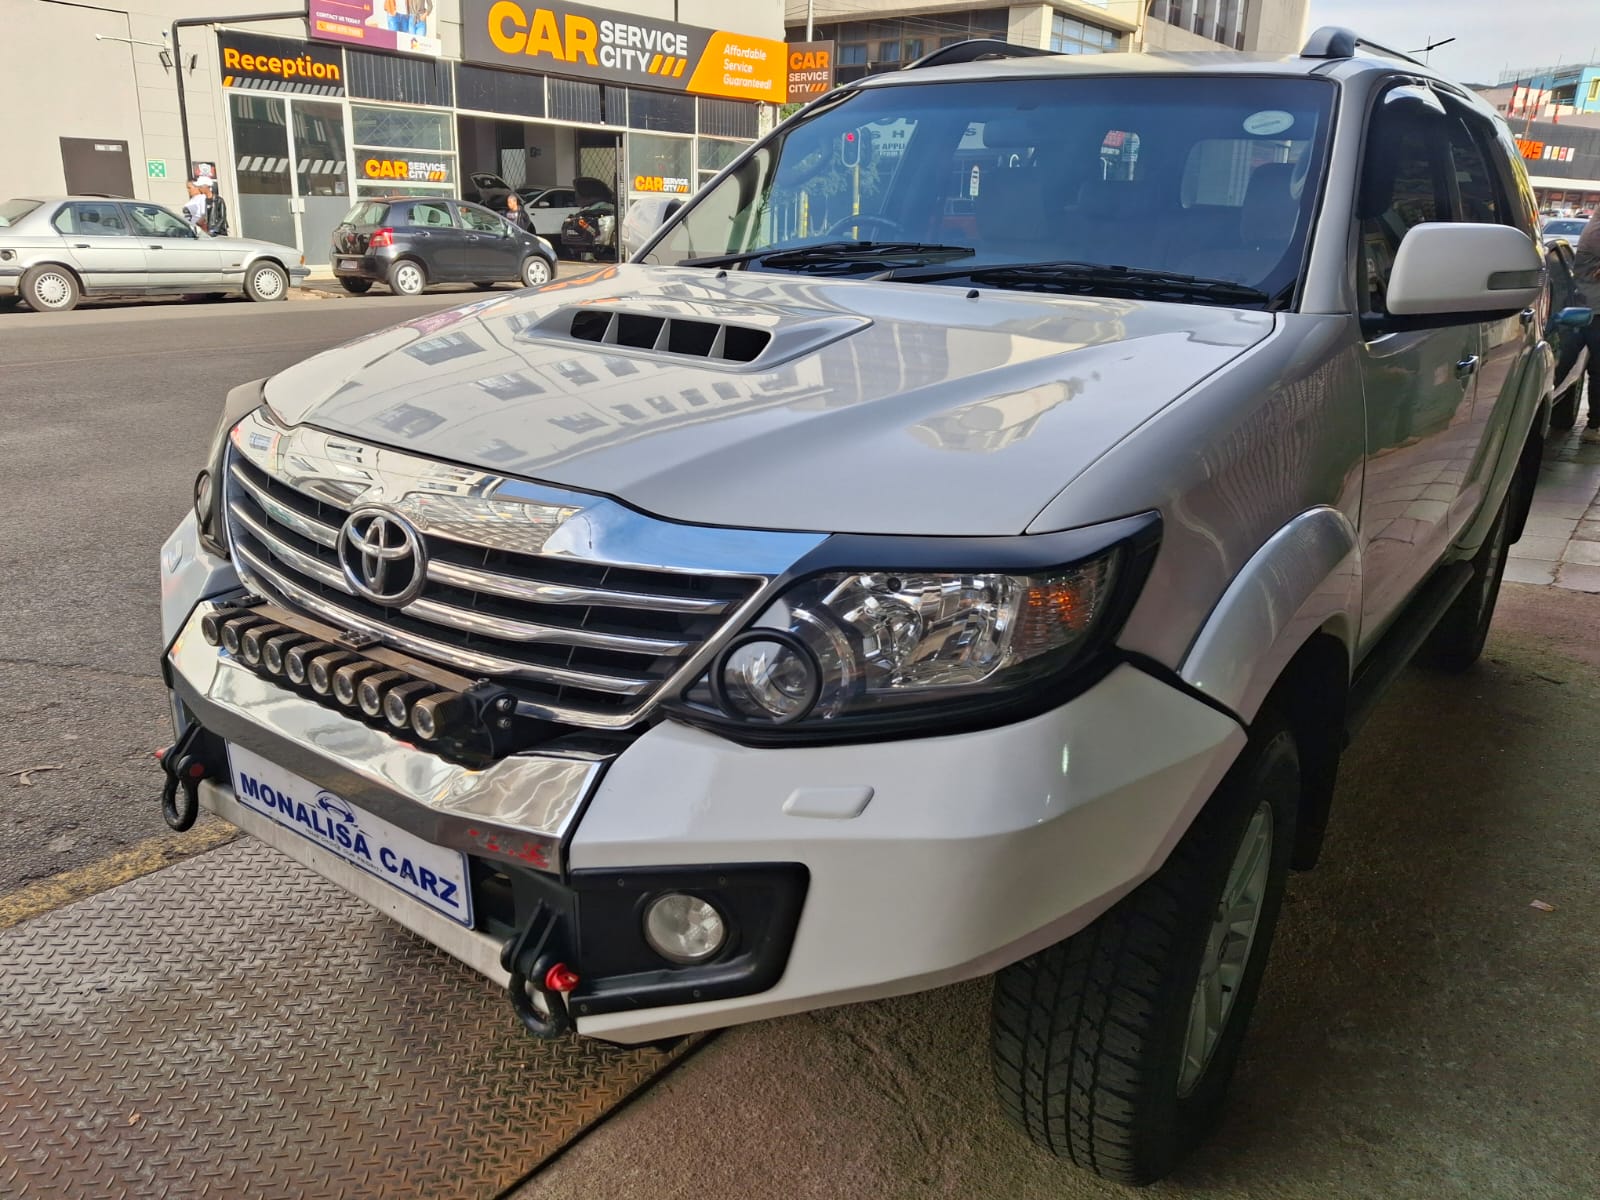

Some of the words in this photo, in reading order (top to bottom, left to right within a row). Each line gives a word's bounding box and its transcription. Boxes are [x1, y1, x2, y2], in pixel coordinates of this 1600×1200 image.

[315, 11, 338, 20] CONTACT
[345, 16, 361, 24] TODAY
[488, 1, 599, 66] CAR
[600, 20, 688, 56] SERVICE
[600, 45, 650, 72] CITY
[723, 44, 767, 60] Affordable
[223, 47, 340, 80] Reception
[723, 59, 753, 73] Service
[789, 51, 830, 70] CAR
[723, 74, 772, 90] Guaranteed!
[788, 71, 829, 82] SERVICE
[788, 83, 811, 93] CITY
[365, 159, 408, 178] CAR
[408, 161, 446, 171] SERVICE
[408, 170, 429, 179] CITY
[663, 177, 689, 186] SERVICE
[634, 175, 664, 192] CAR
[663, 184, 678, 192] CITY
[240, 772, 372, 860] MONALISA
[379, 847, 460, 908] CARZ
